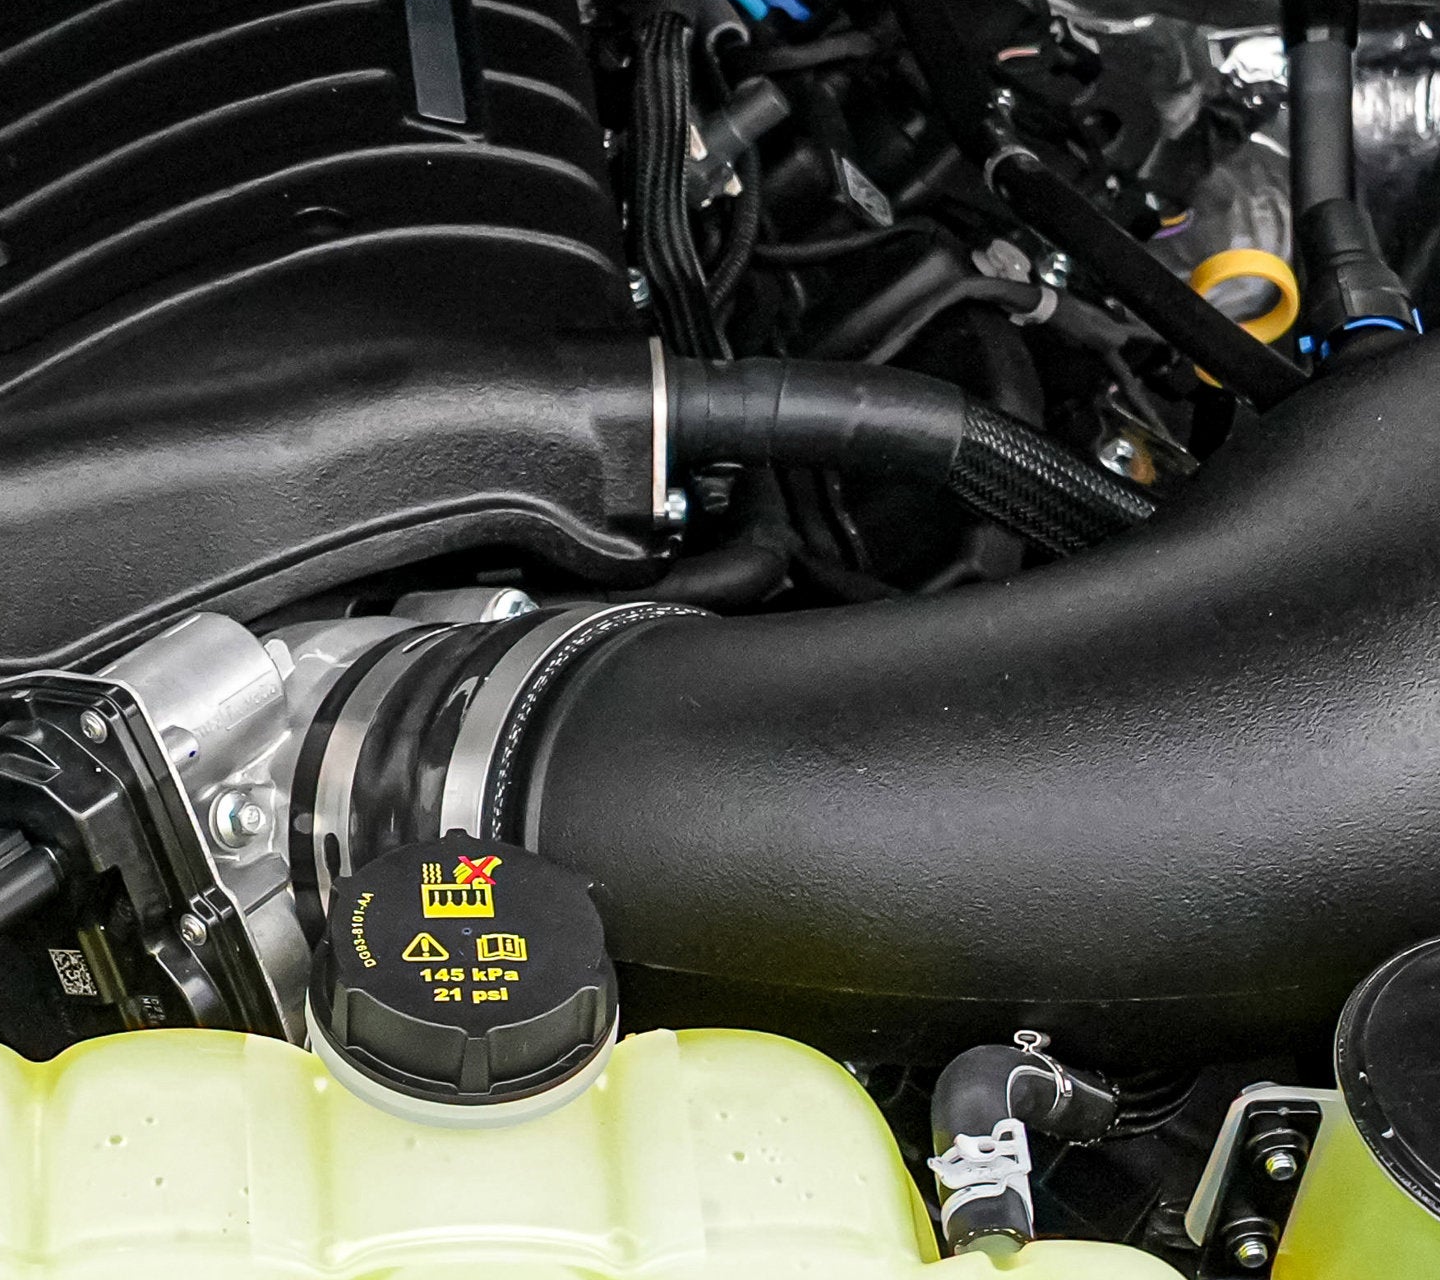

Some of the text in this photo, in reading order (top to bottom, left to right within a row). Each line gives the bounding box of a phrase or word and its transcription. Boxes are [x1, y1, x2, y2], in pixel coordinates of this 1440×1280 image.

[351, 891, 378, 969] DG93-8101-AA
[420, 967, 520, 982] 145 kPa
[433, 987, 509, 1005] 21 psi
